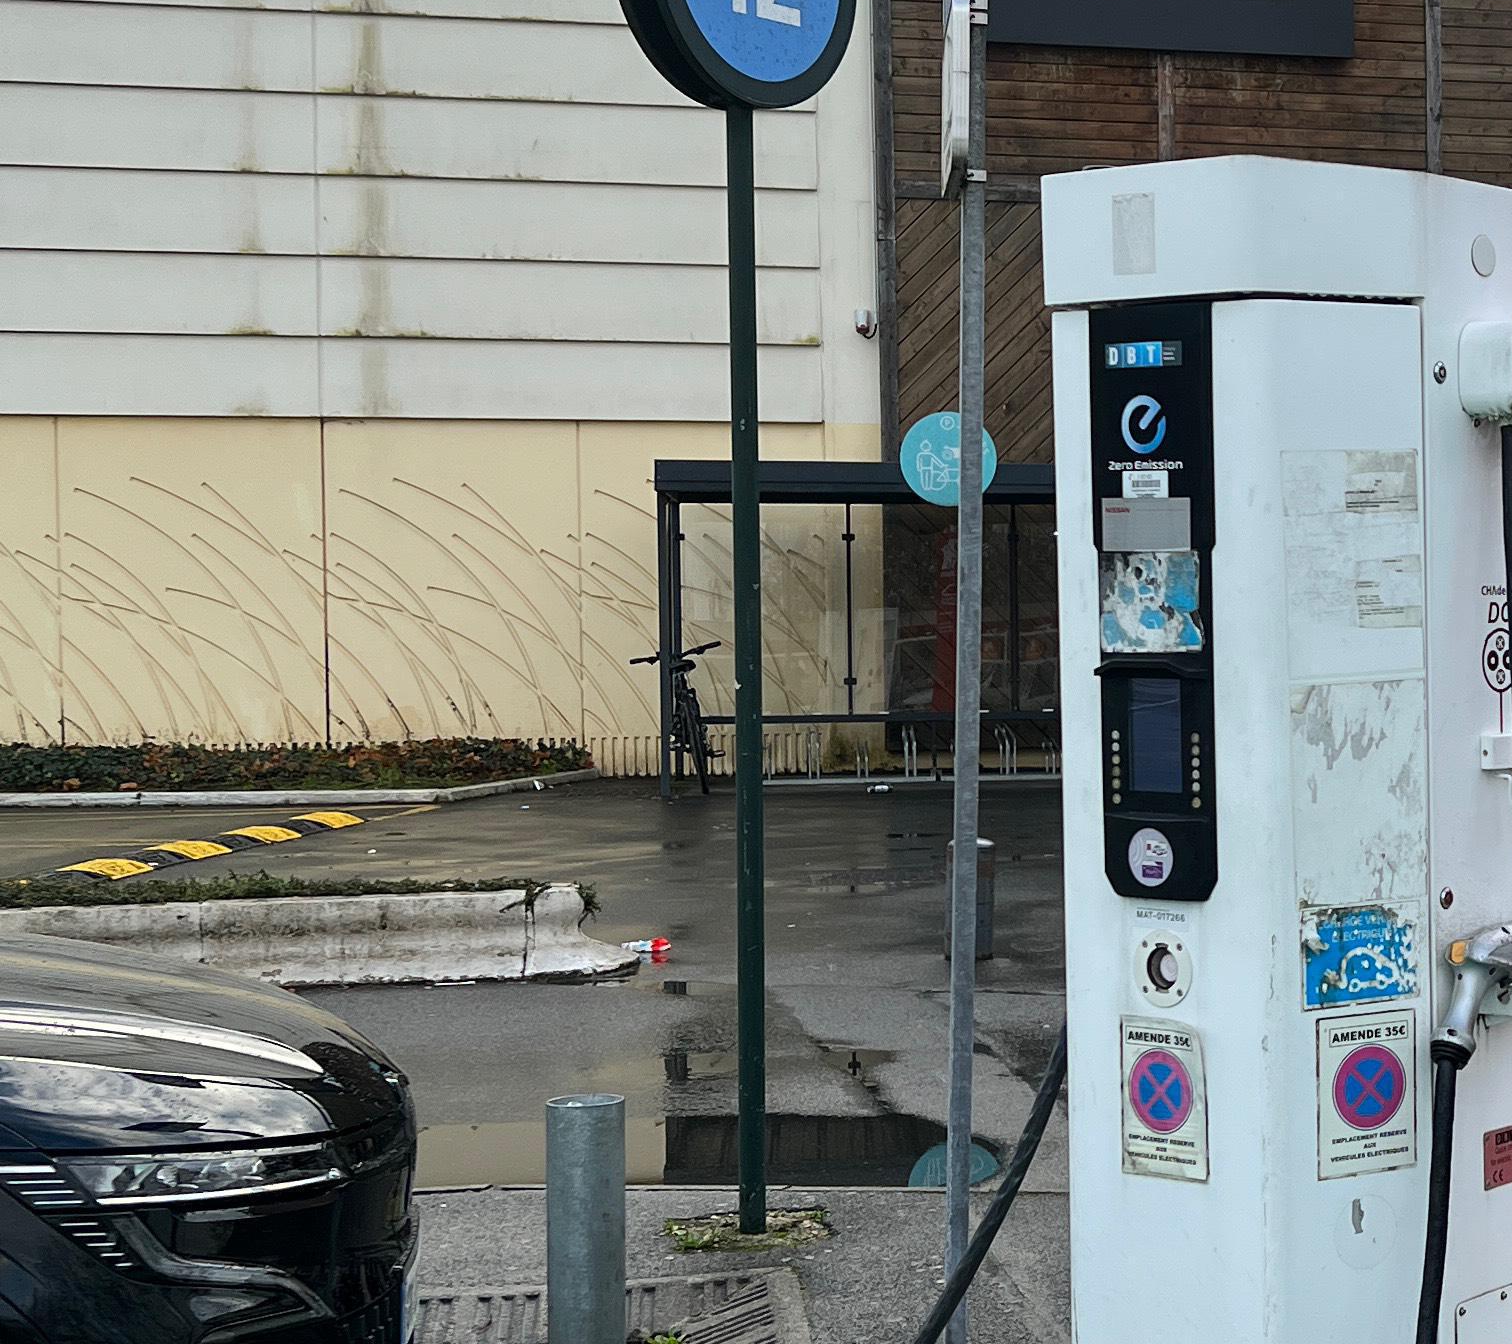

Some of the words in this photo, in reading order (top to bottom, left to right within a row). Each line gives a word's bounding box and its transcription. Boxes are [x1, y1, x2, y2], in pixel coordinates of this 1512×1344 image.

[1108, 345, 1157, 365] DBT
[1108, 460, 1133, 471] Zero
[1134, 459, 1184, 470] Emission
[1481, 585, 1506, 596] CHAde
[1128, 1030, 1172, 1045] AMENDE
[1332, 1027, 1382, 1043] AMENDE
[1384, 1024, 1406, 1037] 35€
